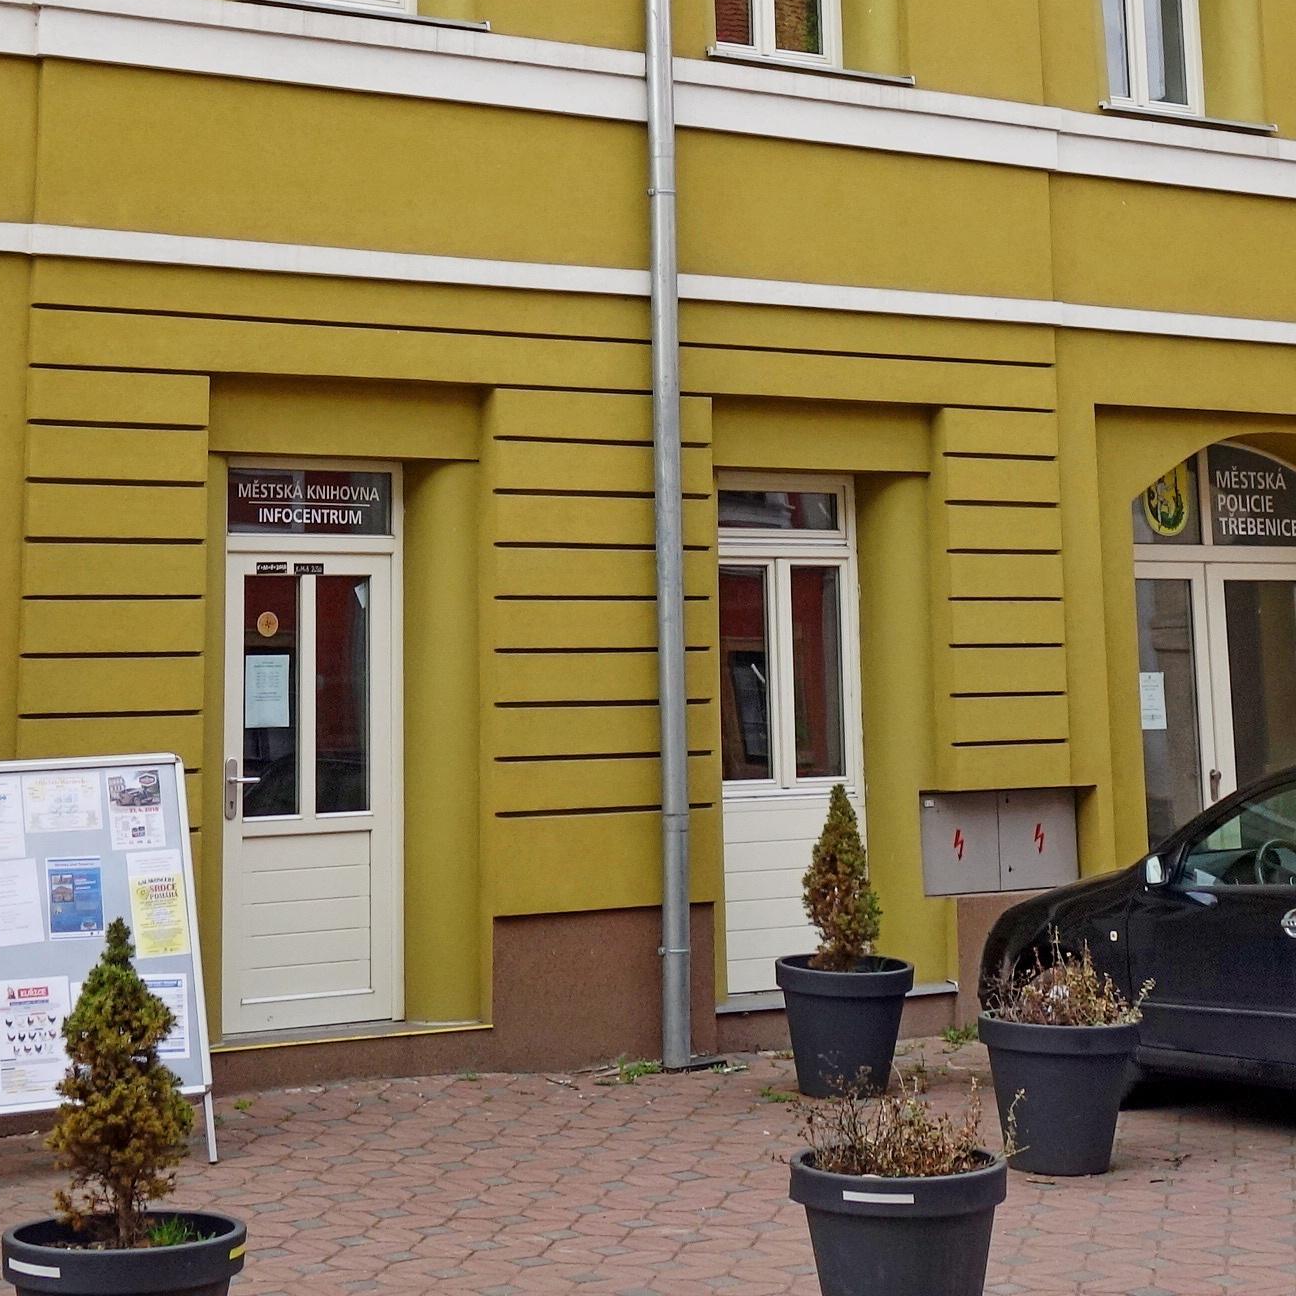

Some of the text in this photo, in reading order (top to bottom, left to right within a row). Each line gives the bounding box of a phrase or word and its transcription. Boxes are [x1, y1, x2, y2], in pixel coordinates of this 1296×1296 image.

[1215, 466, 1287, 491] MĚSTSKÁ
[238, 479, 380, 502] MĚSTSKÁ KNIHOVNA
[1217, 494, 1274, 513] POLICIE
[258, 507, 363, 525] INFOCENTRUM
